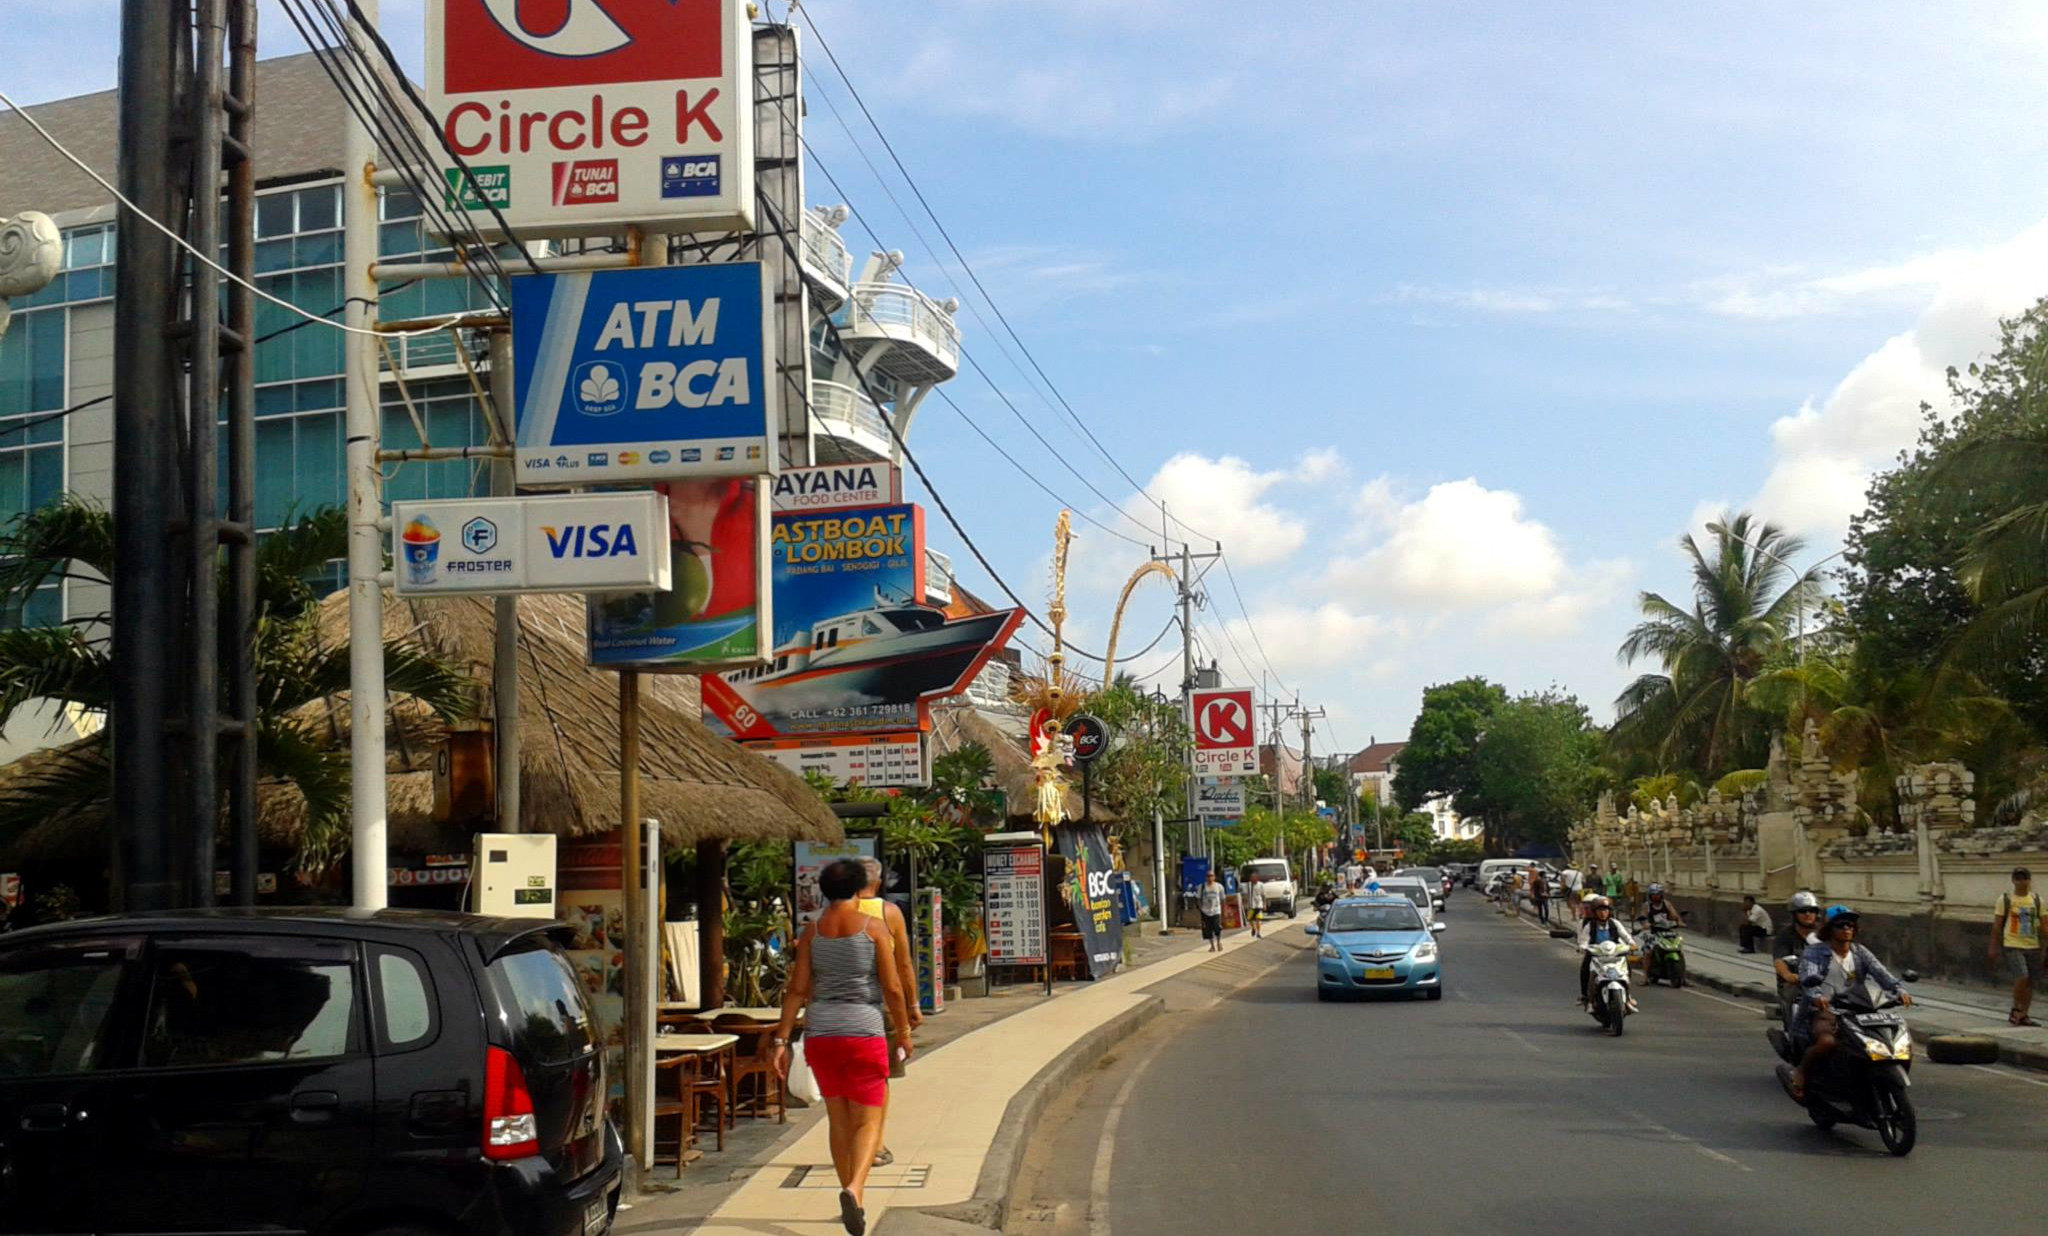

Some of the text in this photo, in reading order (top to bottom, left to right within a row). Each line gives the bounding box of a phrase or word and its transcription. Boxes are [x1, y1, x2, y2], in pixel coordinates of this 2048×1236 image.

[445, 88, 723, 156] Circle K
[574, 166, 613, 181] TUNAI
[683, 162, 717, 177] BCA
[468, 173, 506, 188] EBIT
[585, 182, 616, 197] BCA
[593, 298, 721, 351] ATM
[635, 357, 750, 410] BCA
[525, 458, 551, 469] VISA
[772, 467, 878, 496] AYANA
[793, 490, 879, 506] FOOD CENTER
[771, 513, 907, 544] ASTBOAT
[540, 524, 638, 559] VISA
[786, 535, 905, 564] LOMBOK
[613, 638, 647, 648] Coconut
[649, 636, 676, 646] Water
[735, 704, 757, 728] 60
[790, 703, 911, 719] CALL +62 361 729818
[1208, 702, 1244, 739] K
[1080, 735, 1099, 745] BGC
[1195, 749, 1254, 763] Circle K
[987, 854, 1008, 867] MONEY
[1088, 869, 1115, 898] BGC
